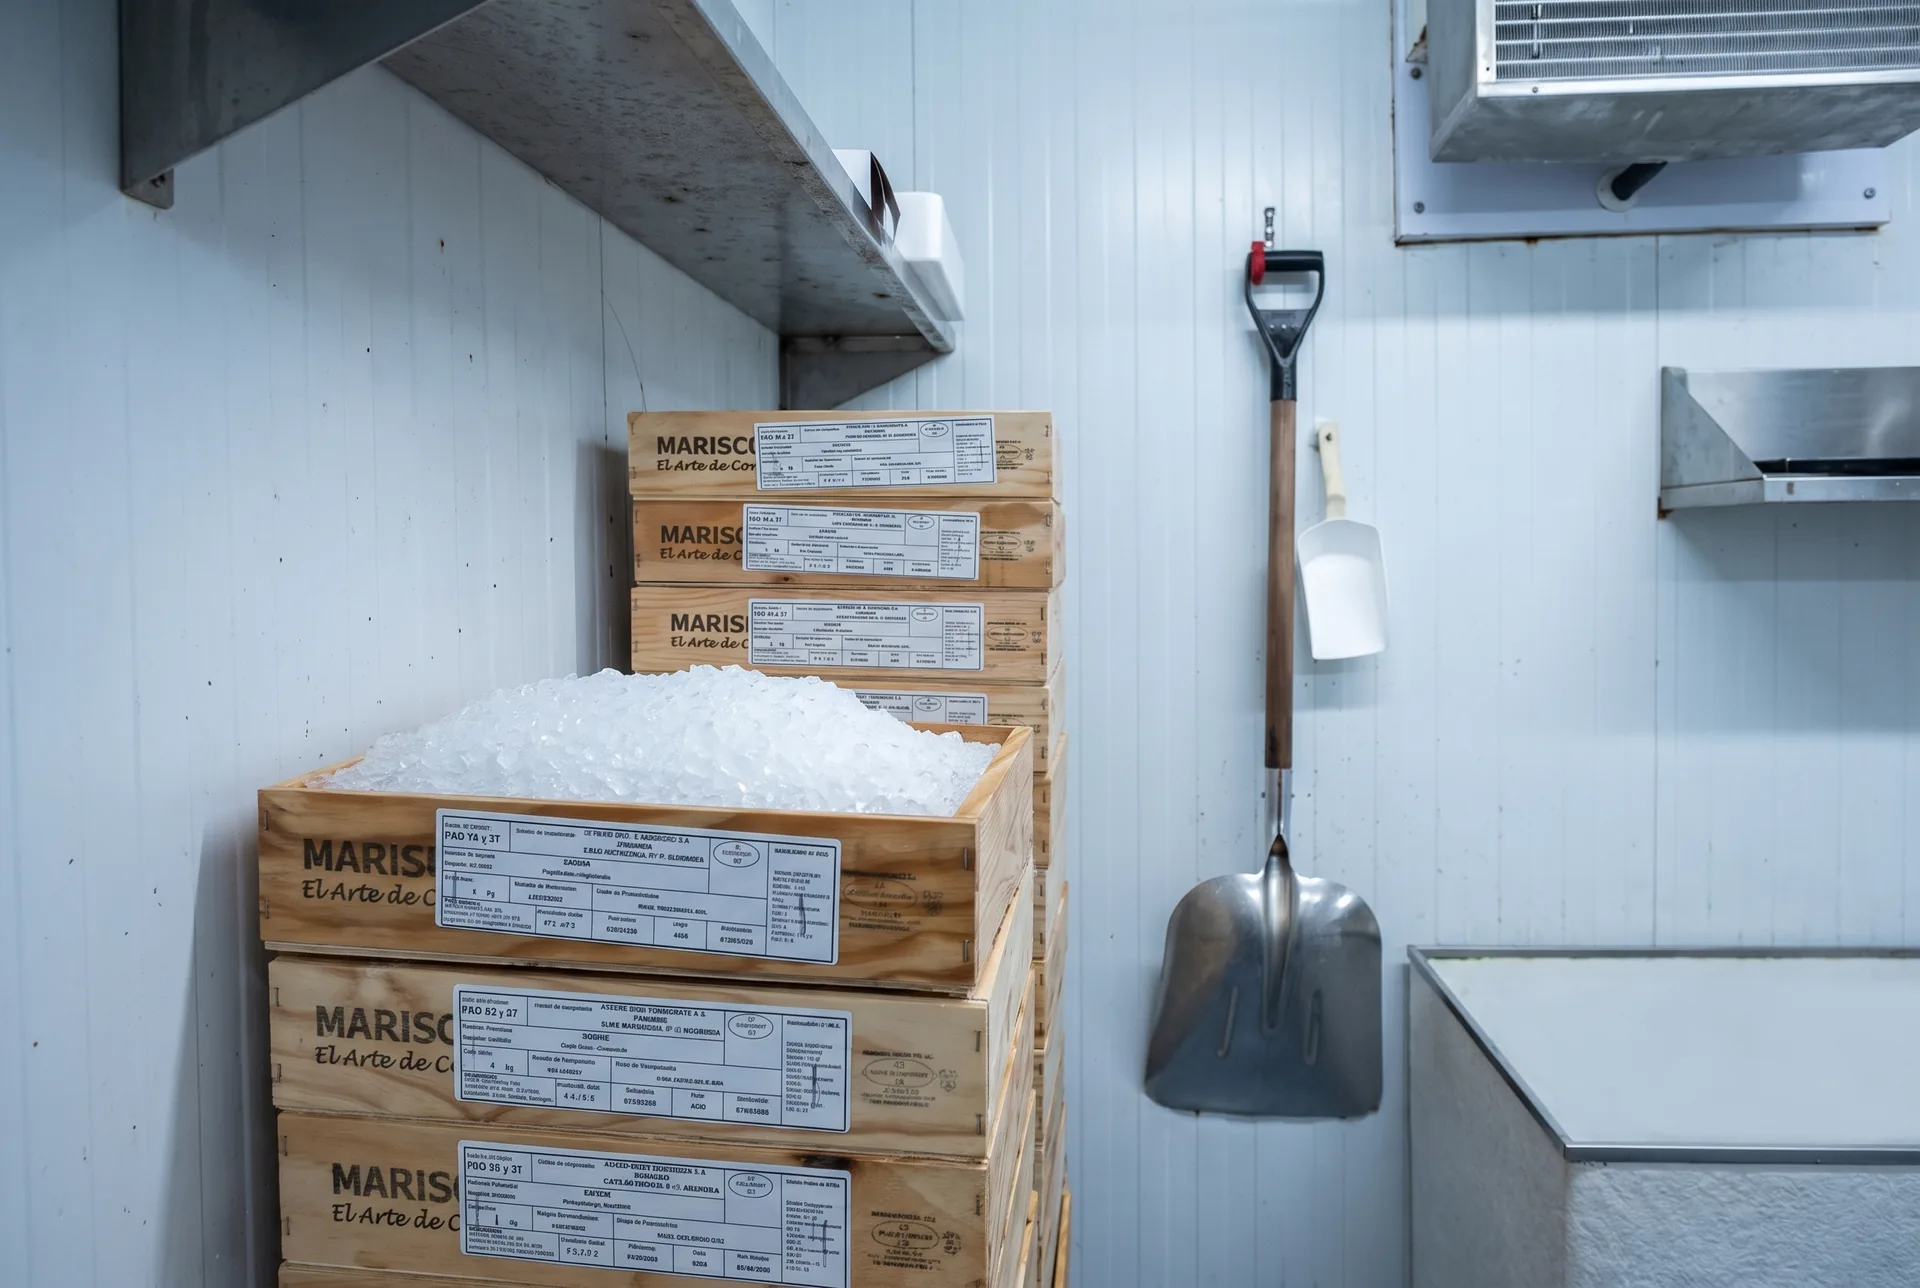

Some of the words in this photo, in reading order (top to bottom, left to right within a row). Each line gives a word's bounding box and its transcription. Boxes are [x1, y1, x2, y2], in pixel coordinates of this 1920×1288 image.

[657, 459, 672, 470] El
[674, 460, 707, 471] Arte
[709, 460, 730, 471] de
[660, 547, 676, 558] El
[677, 548, 710, 559] Arte
[712, 549, 731, 560] de
[671, 614, 748, 633] MARIS
[671, 636, 686, 647] El
[688, 637, 719, 648] Arte
[721, 637, 740, 648] de
[445, 831, 465, 841] PAO
[302, 879, 329, 899] El
[330, 883, 386, 903] Arte
[387, 884, 420, 905] de
[499, 1011, 504, 1019] y
[315, 1005, 455, 1046] MARISC
[315, 1047, 342, 1064] El
[343, 1050, 395, 1068] Arte
[399, 1051, 433, 1071] de
[503, 1167, 508, 1175] y
[331, 1162, 460, 1203] MARIS
[332, 1203, 358, 1222] El
[359, 1208, 412, 1227] Arte
[414, 1209, 447, 1229] de
